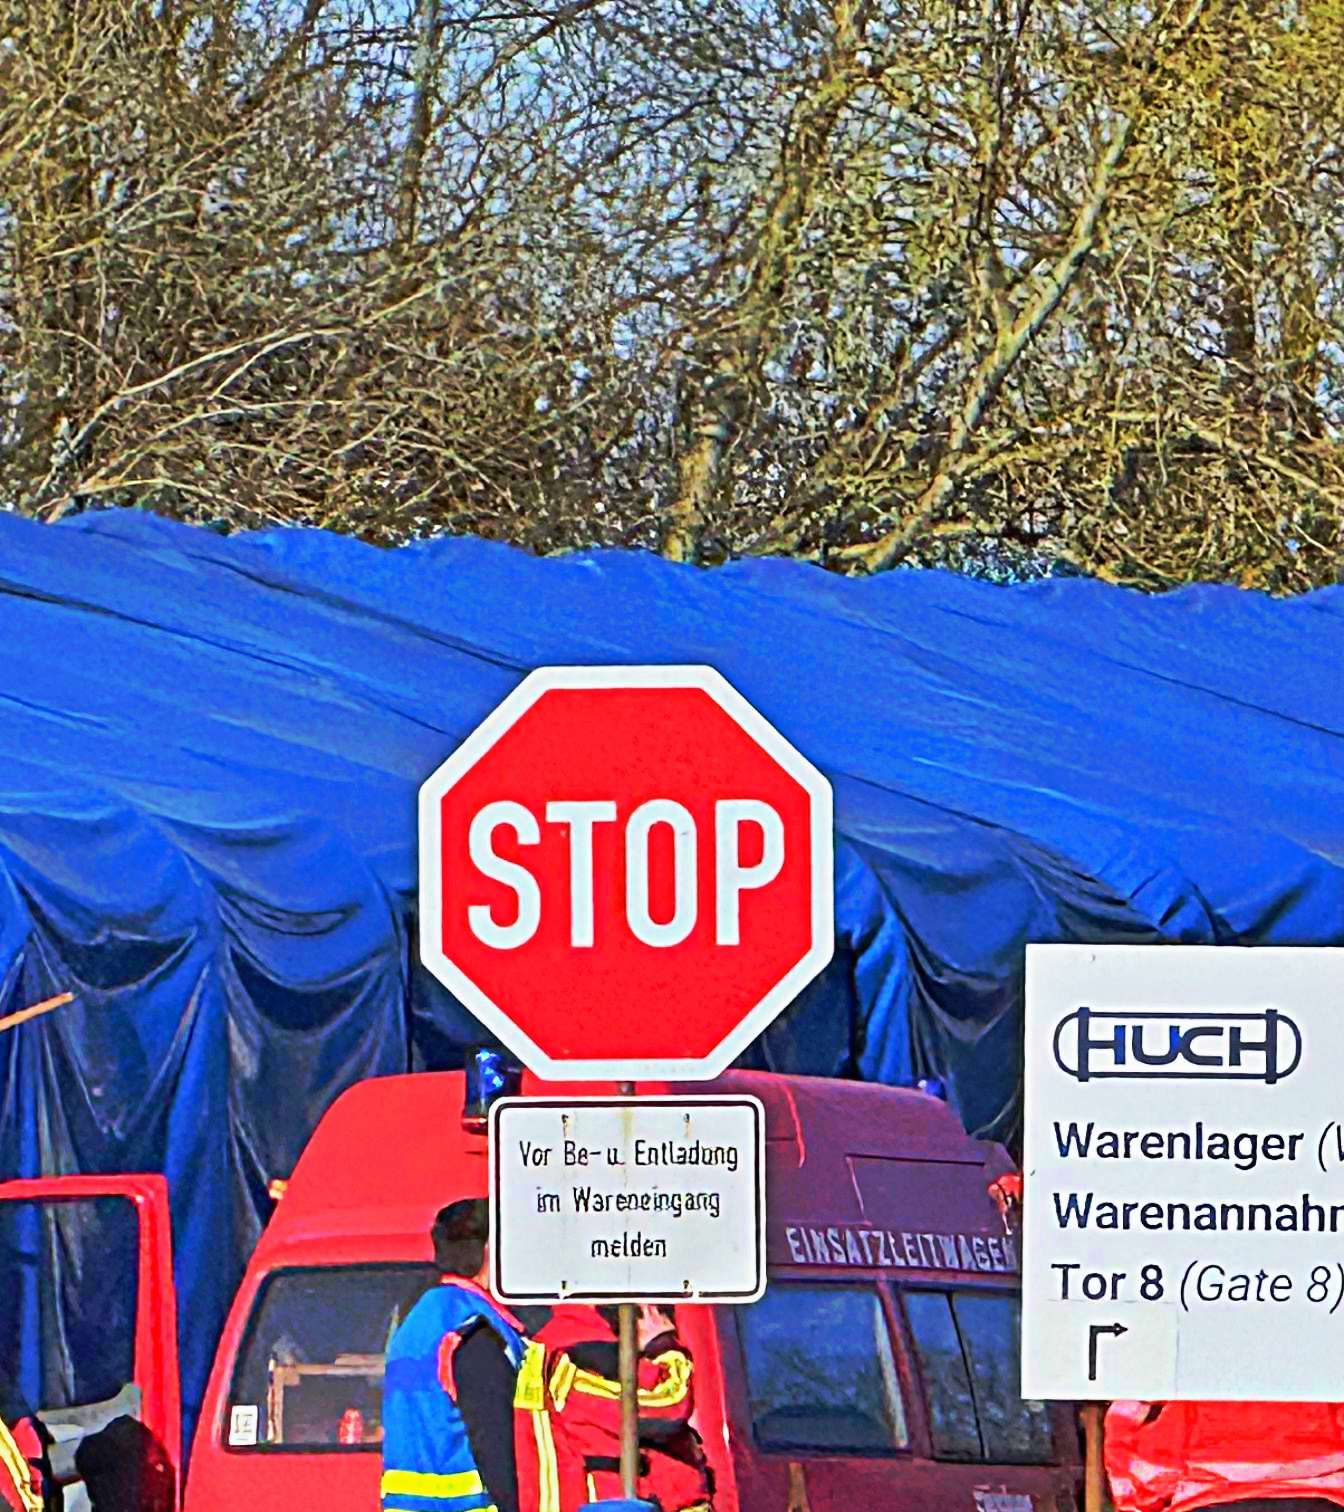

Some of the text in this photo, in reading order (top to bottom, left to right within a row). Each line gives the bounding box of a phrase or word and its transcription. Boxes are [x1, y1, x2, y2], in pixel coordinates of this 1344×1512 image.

[467, 798, 786, 950] STOP
[1076, 1006, 1279, 1085] HUCH
[519, 1140, 553, 1167] Vor
[634, 1139, 739, 1172] Entladung
[1053, 1121, 1304, 1171] Warenlager
[536, 1185, 721, 1218] im Wareneingang
[590, 1231, 668, 1258] melden
[1051, 1259, 1344, 1315] Tor 8 (Gate 8)
